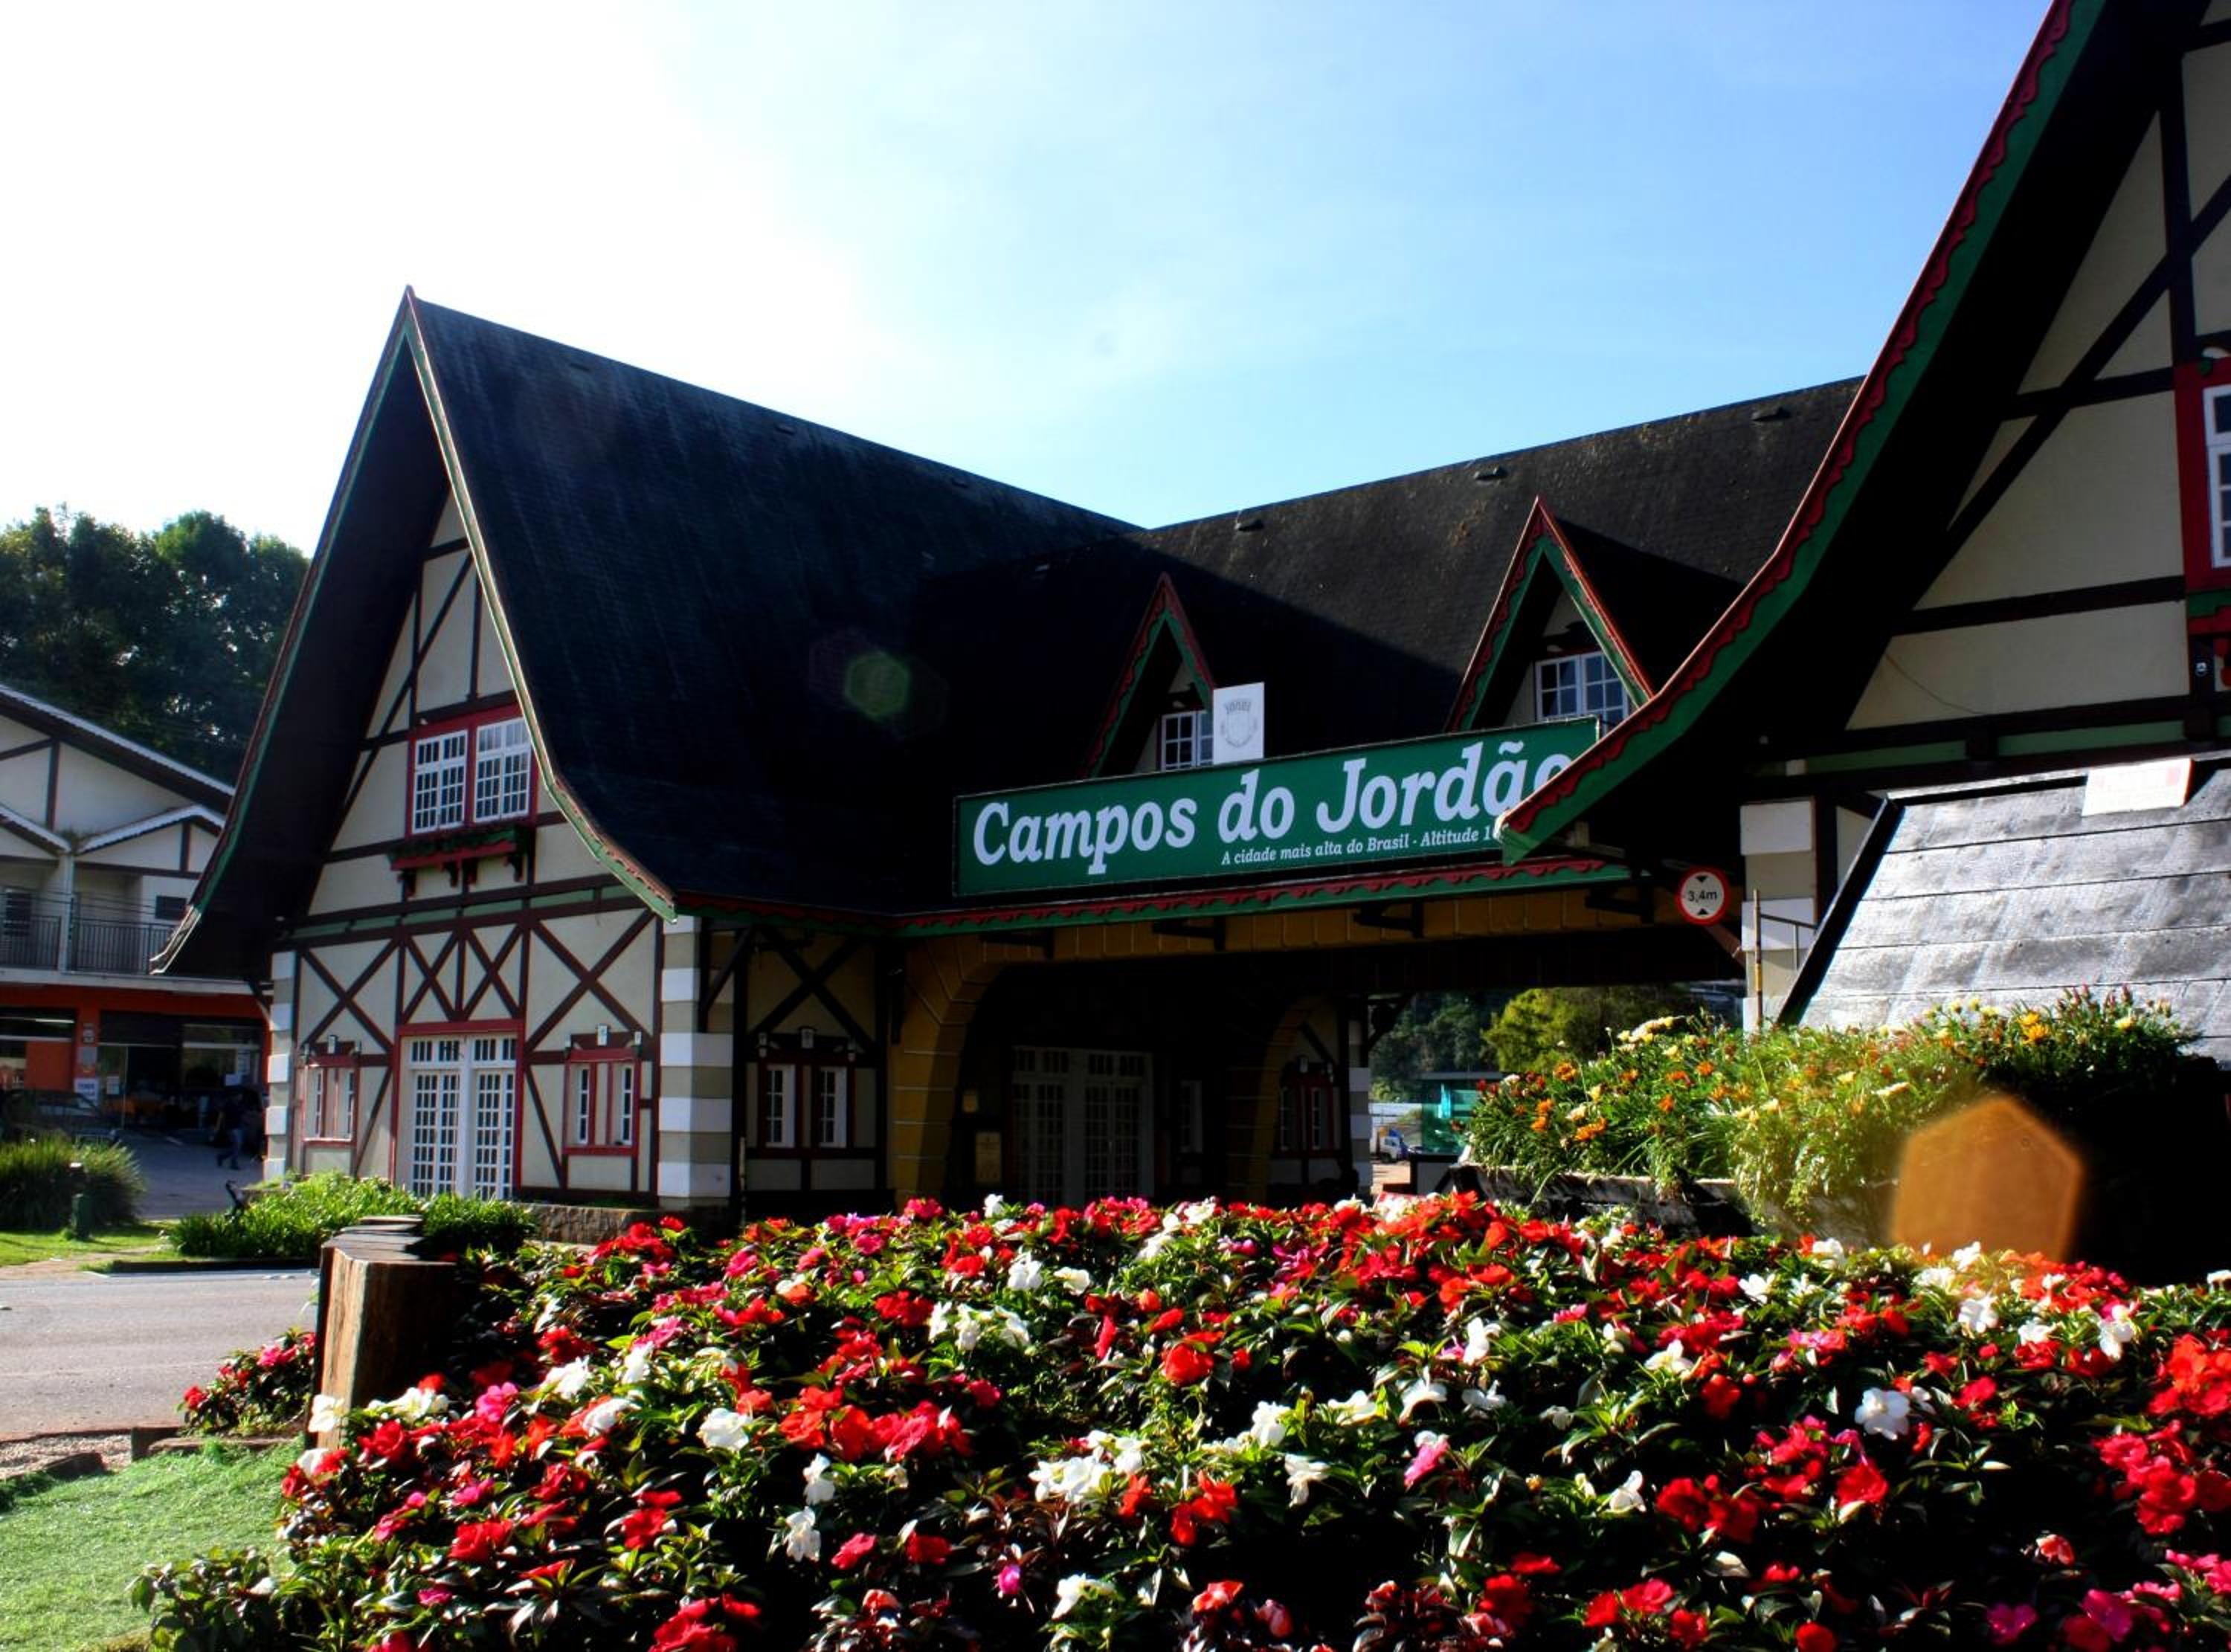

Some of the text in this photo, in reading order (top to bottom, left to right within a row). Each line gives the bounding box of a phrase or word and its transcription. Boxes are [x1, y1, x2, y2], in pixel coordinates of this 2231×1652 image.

[973, 798, 1198, 875] Campos
[1217, 768, 1295, 844] do
[1221, 851, 1231, 865] A
[1234, 847, 1277, 865] cidade
[1280, 844, 1312, 860] mais
[1315, 841, 1342, 856] alta
[1347, 839, 1363, 854] do
[1367, 833, 1410, 852] Brasil
[1420, 827, 1479, 848] Altitude
[1688, 890, 1717, 903] 3,4m
